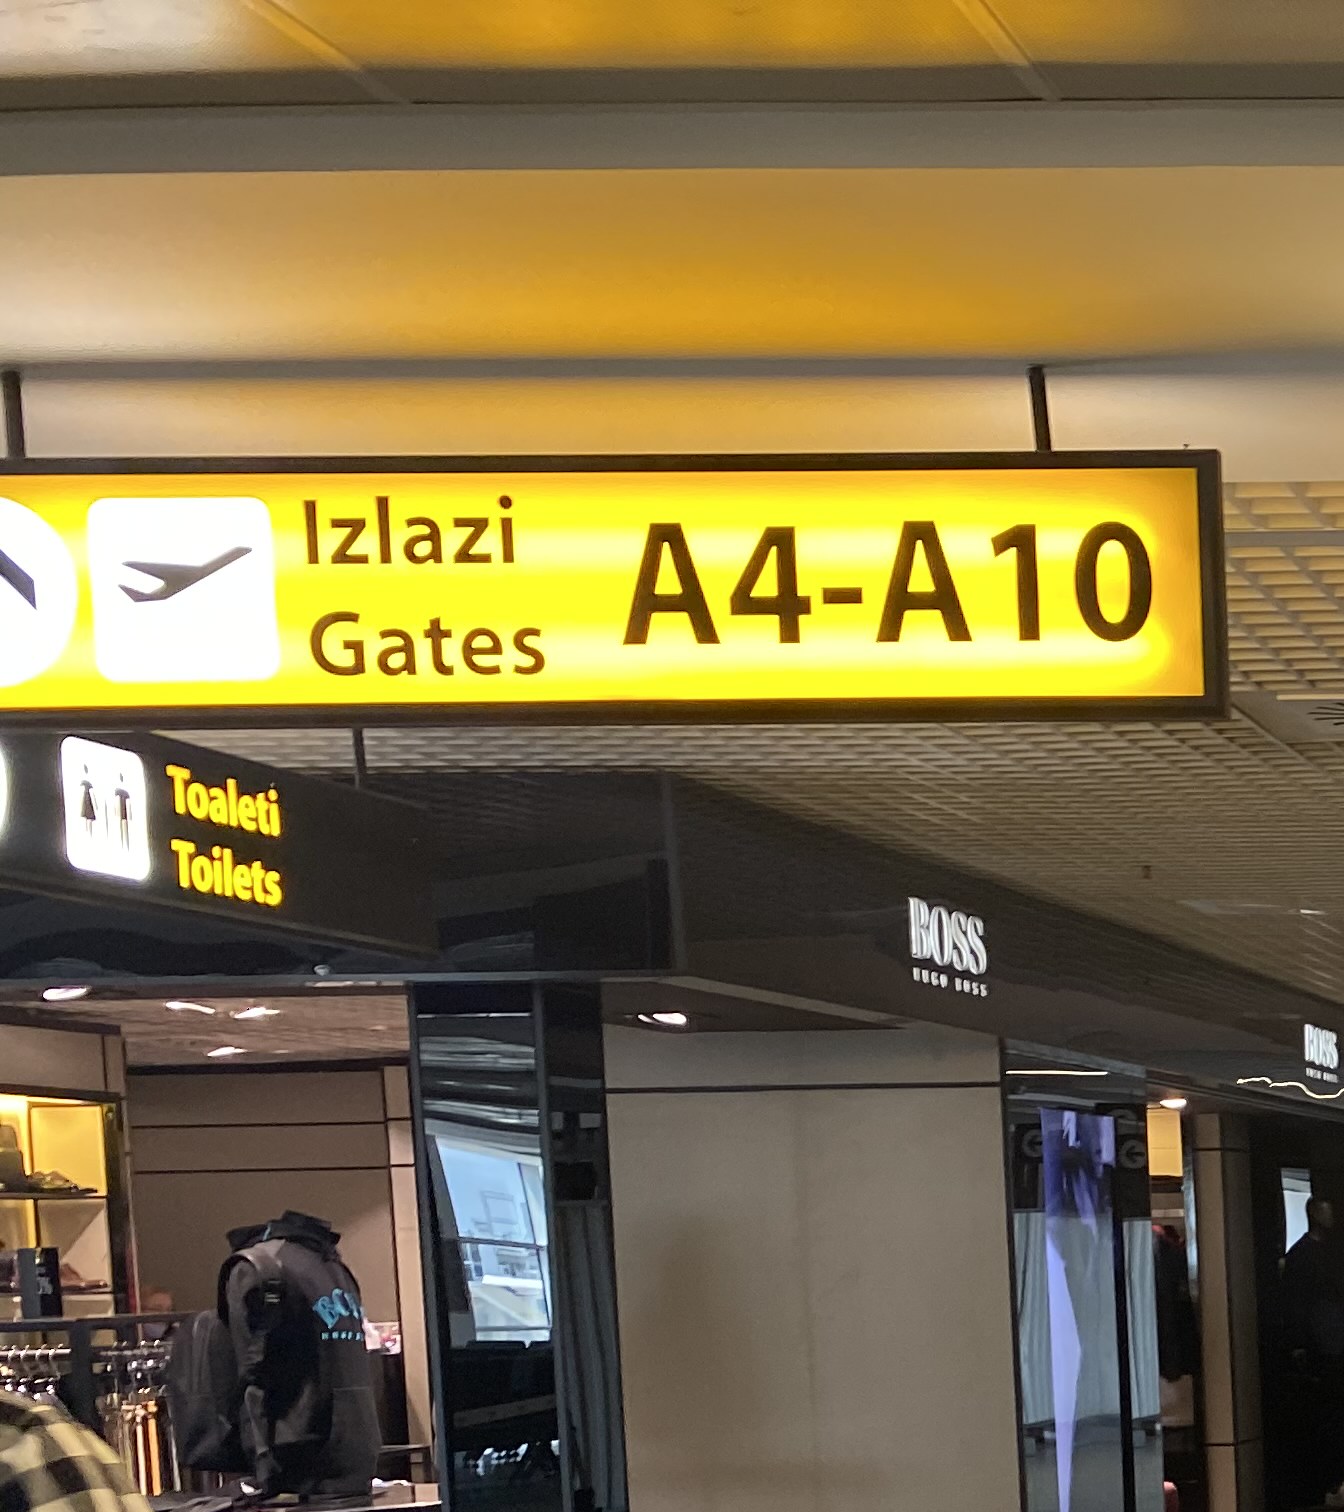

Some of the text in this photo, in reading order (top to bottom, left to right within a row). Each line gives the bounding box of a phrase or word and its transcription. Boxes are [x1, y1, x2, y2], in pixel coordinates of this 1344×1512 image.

[303, 494, 515, 565] Izlazi
[622, 520, 1154, 645] A4-A10
[309, 610, 546, 677] Gates
[165, 764, 282, 838] Toaleti
[170, 838, 283, 907] Toilets
[907, 896, 988, 976] BOSS
